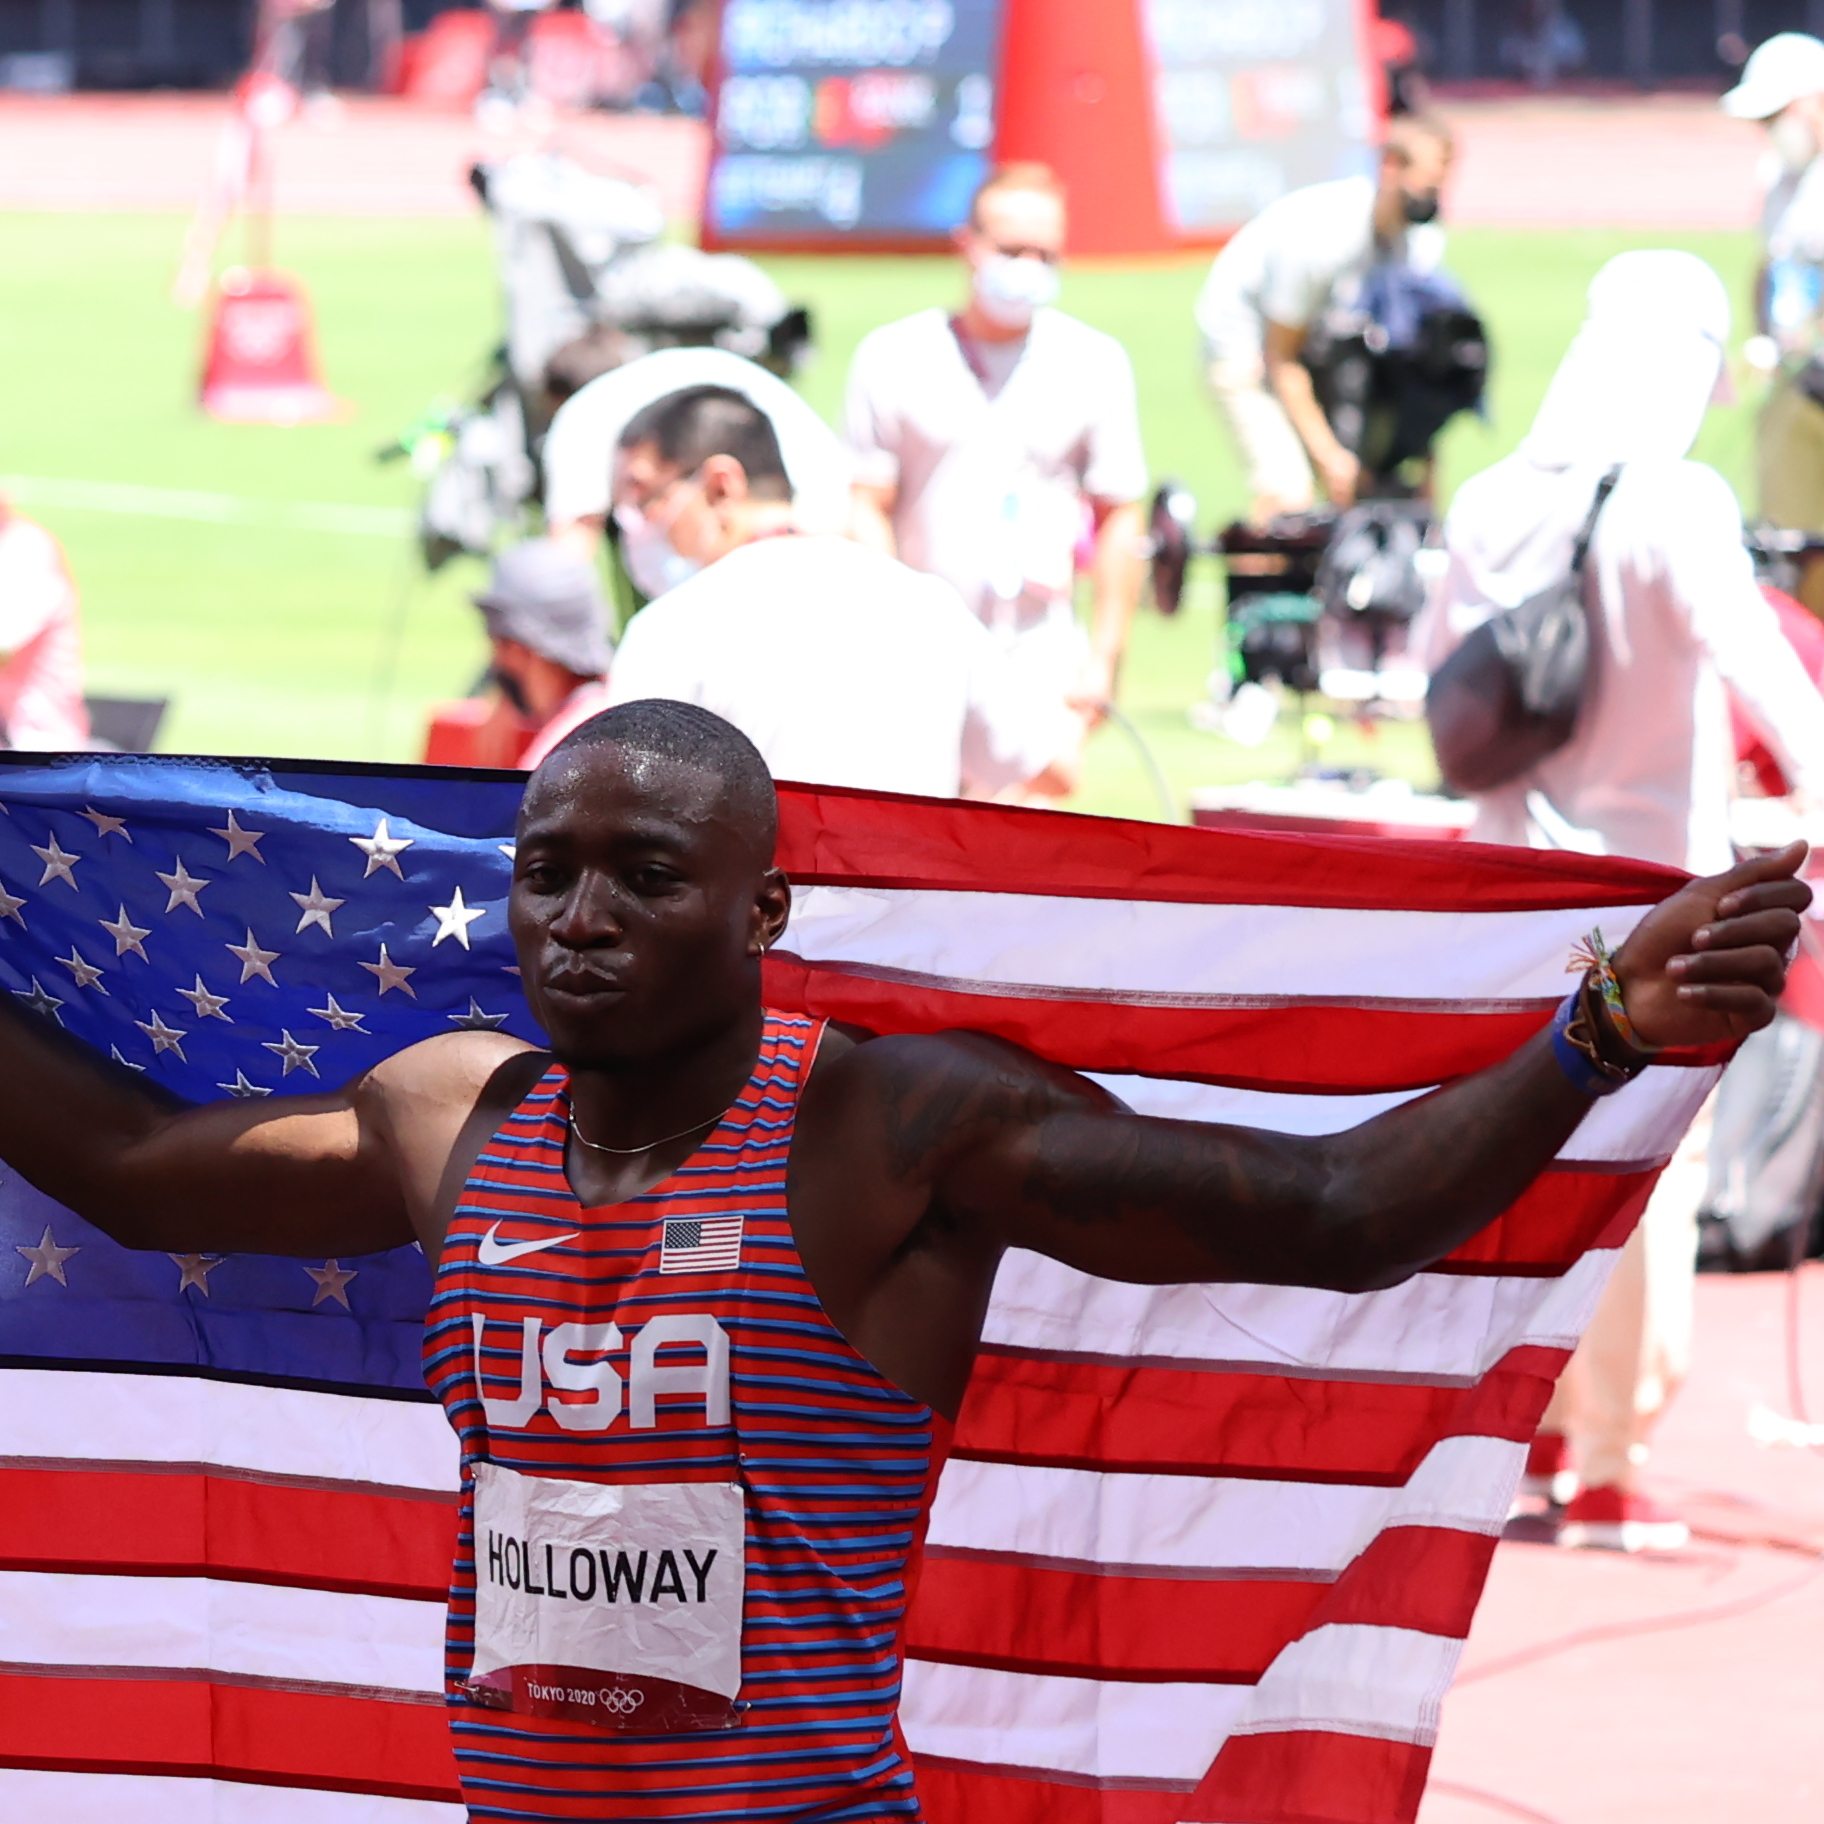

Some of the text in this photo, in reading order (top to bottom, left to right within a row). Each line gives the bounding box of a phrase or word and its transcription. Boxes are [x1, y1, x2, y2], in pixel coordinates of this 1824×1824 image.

[471, 1310, 732, 1432] USA
[488, 1529, 719, 1604] HOLLOWAY
[526, 1682, 596, 1706] TOKYO 2020
